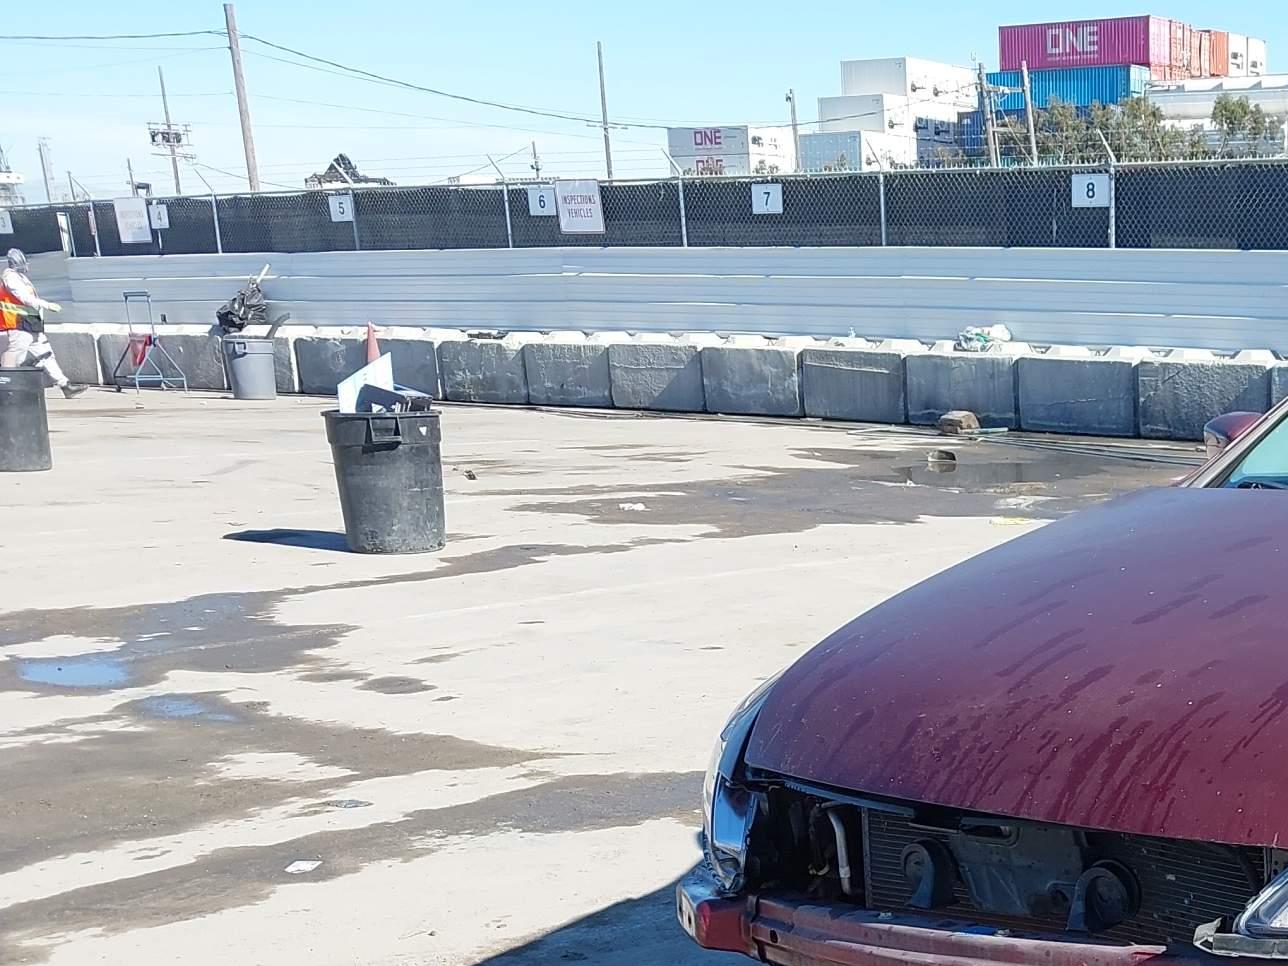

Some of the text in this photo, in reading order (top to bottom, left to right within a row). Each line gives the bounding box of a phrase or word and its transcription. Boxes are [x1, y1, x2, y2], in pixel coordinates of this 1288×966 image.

[1047, 26, 1098, 53] ONE
[694, 130, 721, 146] ONE
[1086, 182, 1095, 199] 8
[538, 195, 546, 209] 6
[561, 194, 596, 205] INSPECTIONS
[763, 192, 770, 206] 7
[338, 201, 345, 214] 5
[567, 207, 593, 218] VEHICLES
[156, 211, 162, 222] 4
